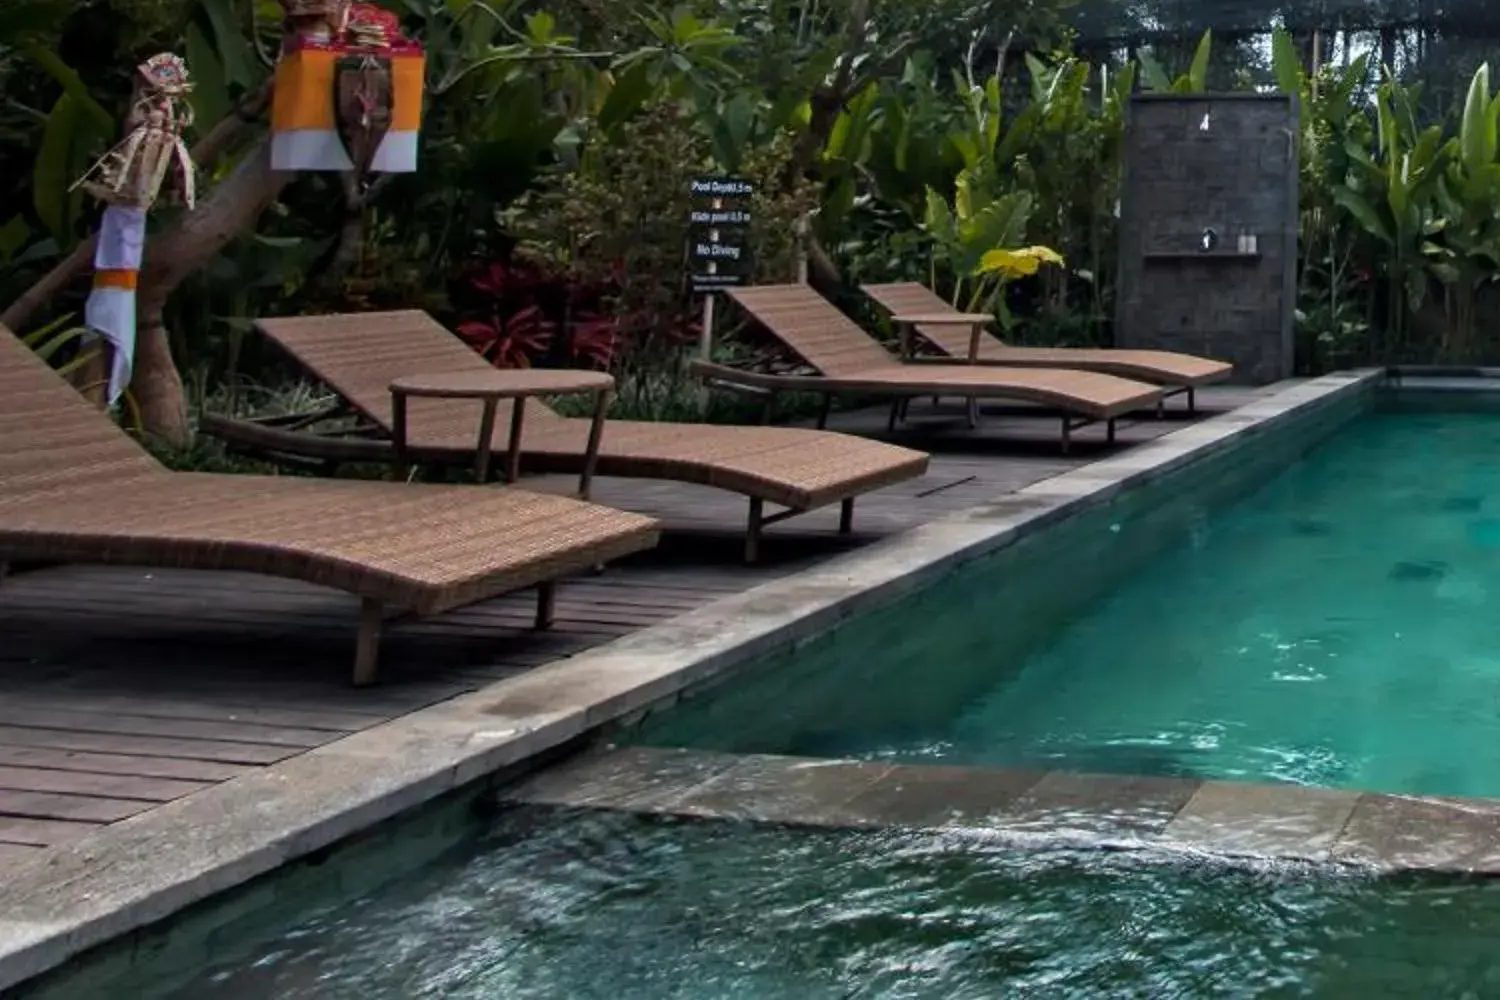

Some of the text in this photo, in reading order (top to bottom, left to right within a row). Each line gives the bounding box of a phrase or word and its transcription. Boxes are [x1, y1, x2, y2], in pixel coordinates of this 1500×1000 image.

[691, 181, 710, 192] Pool
[697, 243, 740, 260] No Diving
